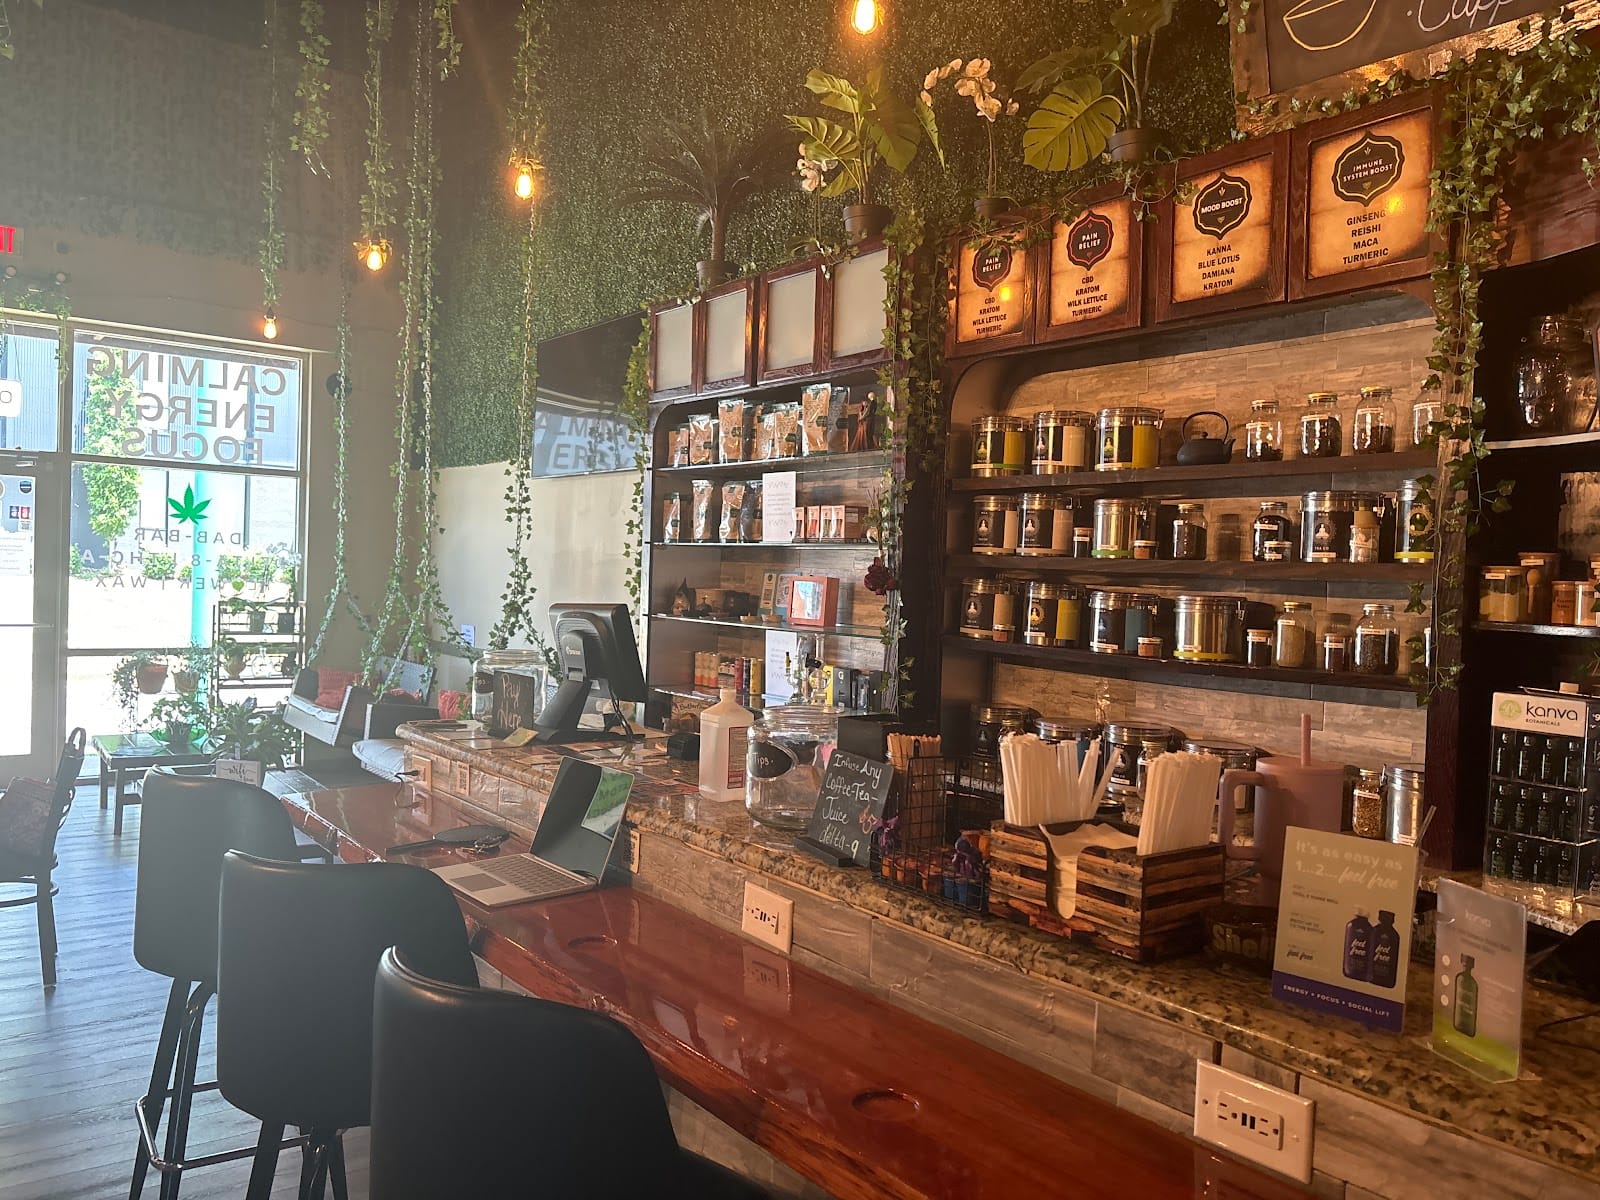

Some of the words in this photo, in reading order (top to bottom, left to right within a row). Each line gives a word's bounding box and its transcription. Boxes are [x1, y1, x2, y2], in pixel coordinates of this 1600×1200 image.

[1353, 159, 1383, 172] IMMUNE
[1342, 170, 1368, 182] SYSTEM
[1370, 164, 1393, 176] BOOST
[1201, 201, 1220, 214] MOOD
[1221, 197, 1243, 209] BOOST
[1346, 210, 1386, 227] GINSENG
[1082, 232, 1098, 242] PAIN
[1351, 225, 1381, 238] REISHI
[1078, 239, 1101, 250] RELIEF
[1206, 244, 1232, 256] KANNA
[1353, 238, 1378, 250] MACA
[985, 256, 999, 264] PAIN
[1198, 258, 1216, 270] BLUE
[1218, 254, 1240, 266] LOTUS
[1342, 248, 1389, 265] TURMERIC
[982, 263, 1002, 272] RELIEF
[1202, 267, 1235, 280] DAMIANA
[1082, 276, 1094, 284] CBD
[1203, 278, 1233, 291] KRATOM
[1076, 285, 1100, 296] KRATOM
[1084, 294, 1108, 304] LETTUCE
[1072, 306, 1102, 317] TURMERIC
[502, 674, 521, 708] Pay
[1526, 701, 1578, 721] kanva
[1526, 718, 1560, 726] BOTANICALS
[860, 761, 882, 790] Any
[822, 796, 848, 825] Juice
[1296, 840, 1317, 855] It's
[1322, 847, 1340, 858] as
[1344, 851, 1380, 869] easy
[1384, 858, 1402, 871] as
[1338, 866, 1368, 884] feel
[1368, 873, 1398, 890] free
[1352, 938, 1366, 948] feel
[1375, 944, 1391, 954] feel
[1283, 984, 1308, 996] ENERGY
[1317, 993, 1340, 1004] FOCUS
[1348, 1002, 1372, 1013] SOCIAL
